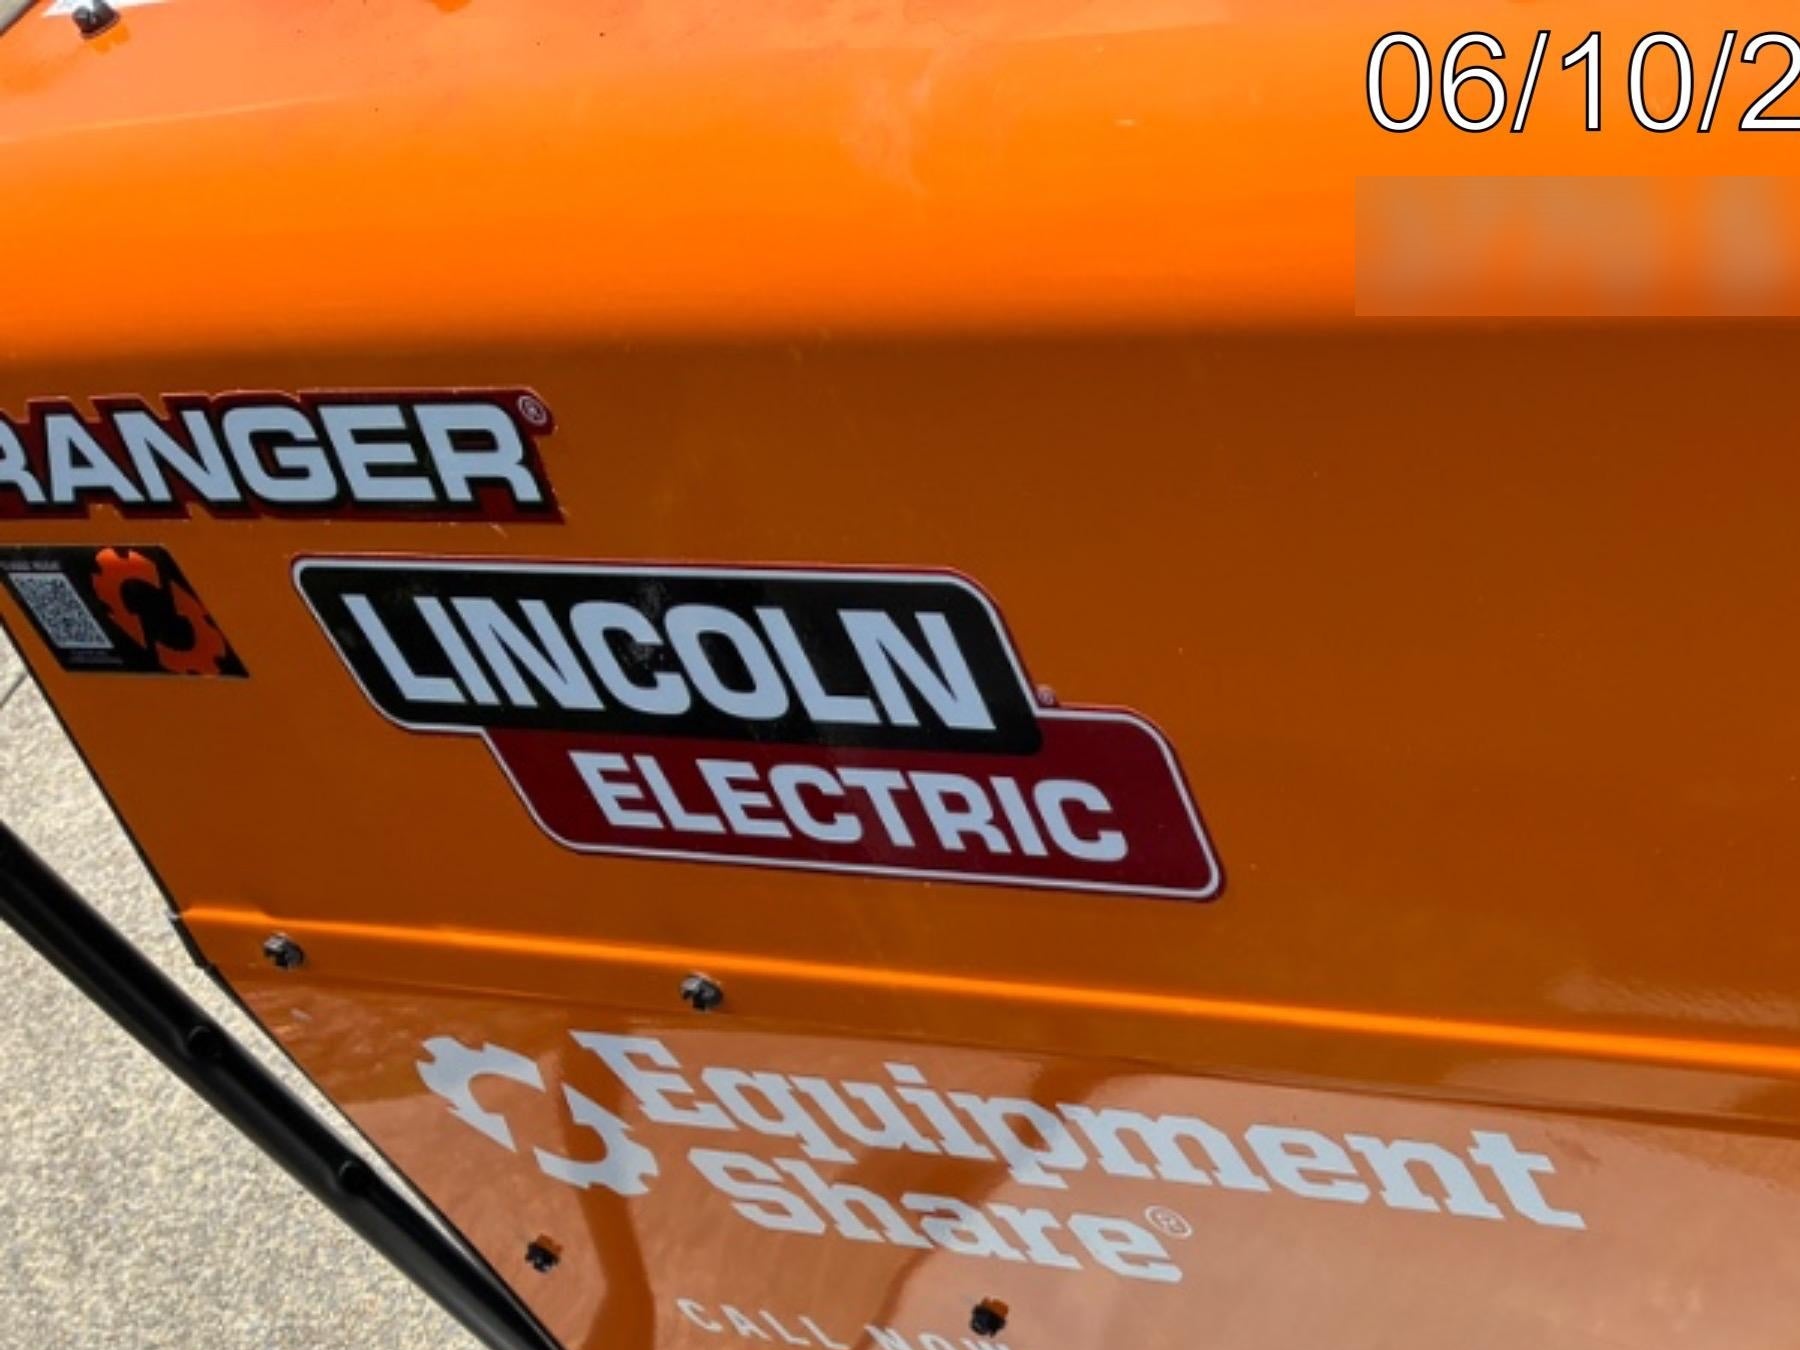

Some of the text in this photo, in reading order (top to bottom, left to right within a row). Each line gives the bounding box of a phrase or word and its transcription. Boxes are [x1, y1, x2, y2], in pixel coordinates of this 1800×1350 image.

[341, 593, 997, 730] LINCOLN
[567, 751, 1128, 862] ELECTRIC
[569, 1031, 1586, 1229] Equipment
[677, 1298, 849, 1350] CALL
